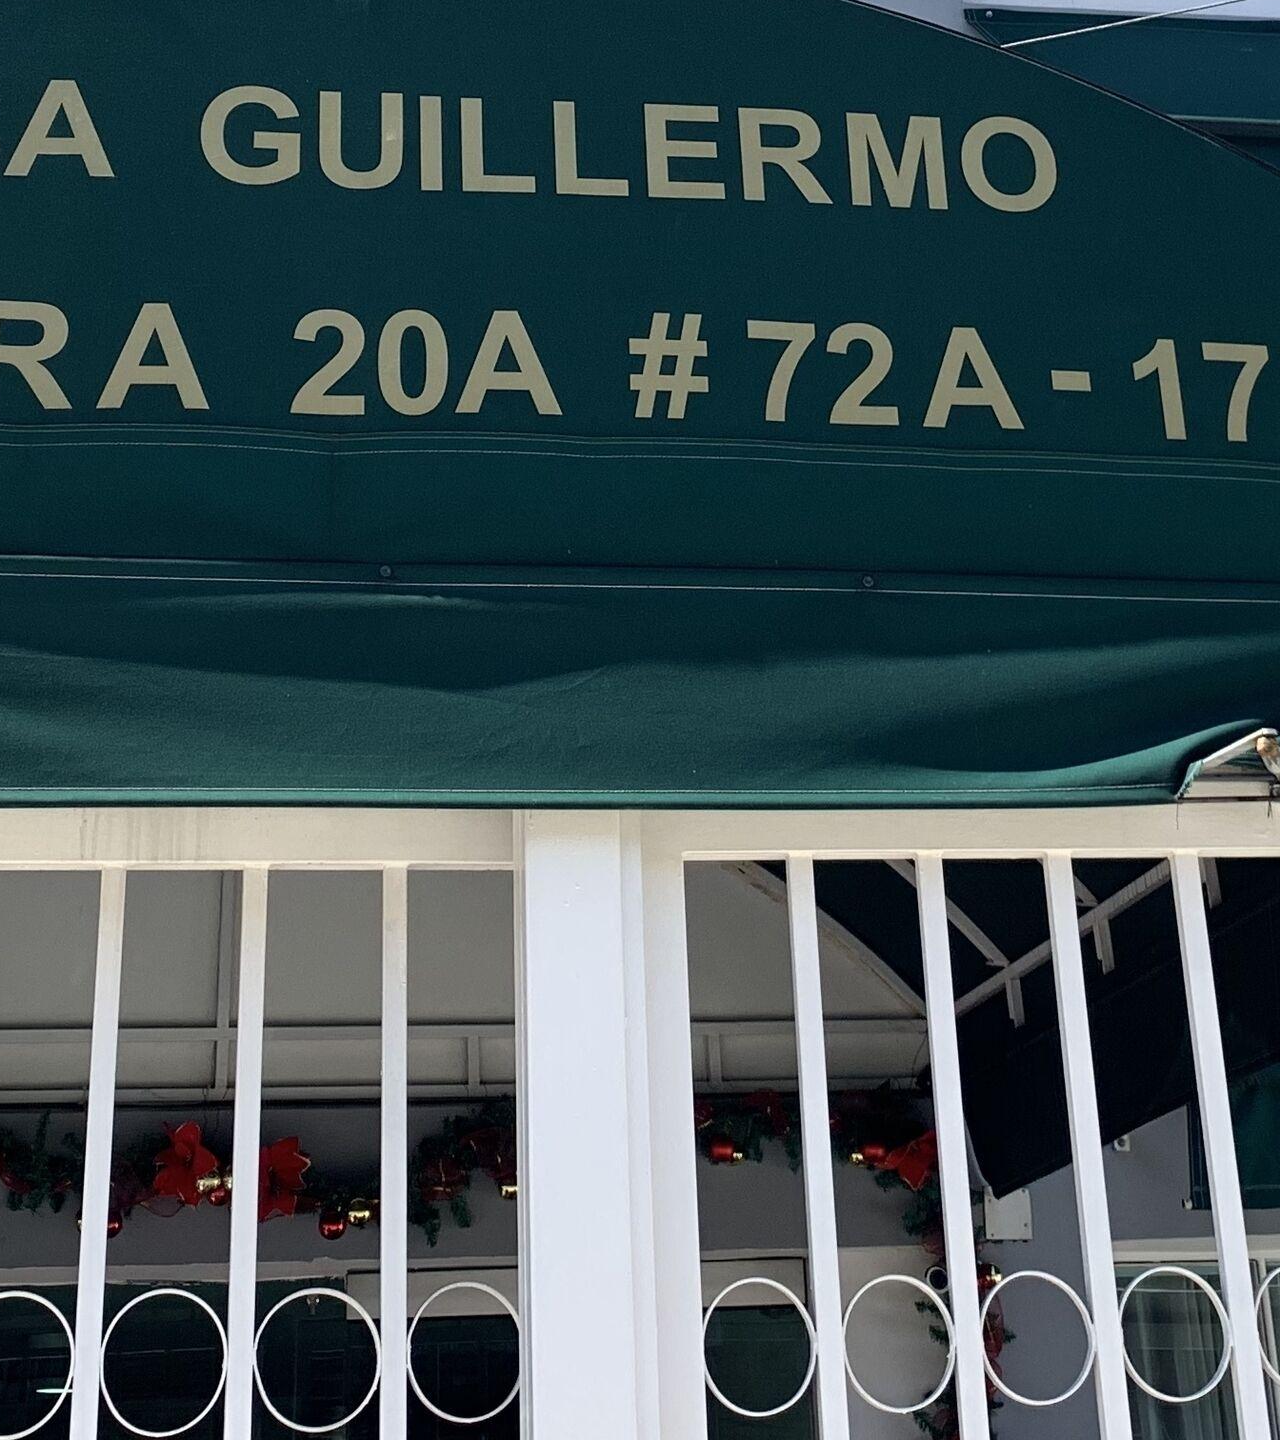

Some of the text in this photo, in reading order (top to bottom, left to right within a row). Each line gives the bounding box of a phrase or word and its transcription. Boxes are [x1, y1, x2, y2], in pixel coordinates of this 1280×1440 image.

[199, 85, 1058, 212] GUILLERMO
[289, 308, 563, 417] 20A
[627, 312, 709, 420] #
[746, 319, 1025, 431] 72A
[1050, 370, 1092, 392] -
[1132, 338, 1270, 443] 17
